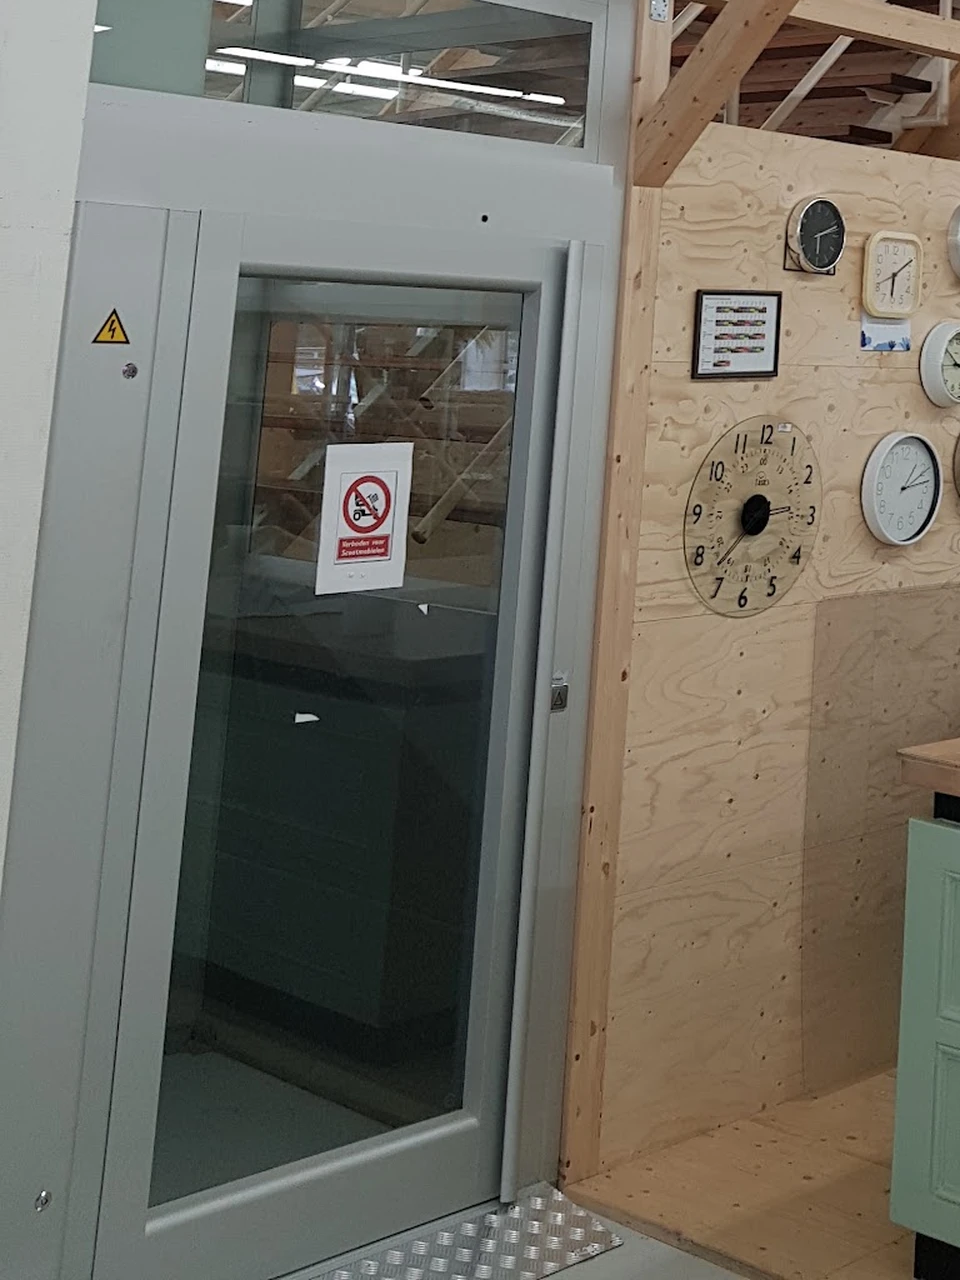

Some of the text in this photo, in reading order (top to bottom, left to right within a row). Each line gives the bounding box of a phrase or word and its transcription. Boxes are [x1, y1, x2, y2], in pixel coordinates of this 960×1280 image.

[734, 433, 748, 454] 11
[760, 424, 774, 445] 12
[790, 436, 796, 456] 1
[900, 446, 911, 461] 12
[709, 460, 725, 482] 10
[803, 464, 813, 484] 2
[876, 482, 884, 496] 9
[692, 504, 702, 525] 9
[806, 506, 816, 525] 3
[879, 500, 886, 514] 8
[888, 513, 894, 526] 7
[897, 516, 904, 530] 6
[908, 511, 915, 526] 5
[694, 545, 705, 566] 8
[791, 544, 802, 566] 4
[710, 577, 724, 599] 7
[766, 576, 777, 597] 5
[738, 587, 748, 608] 6
